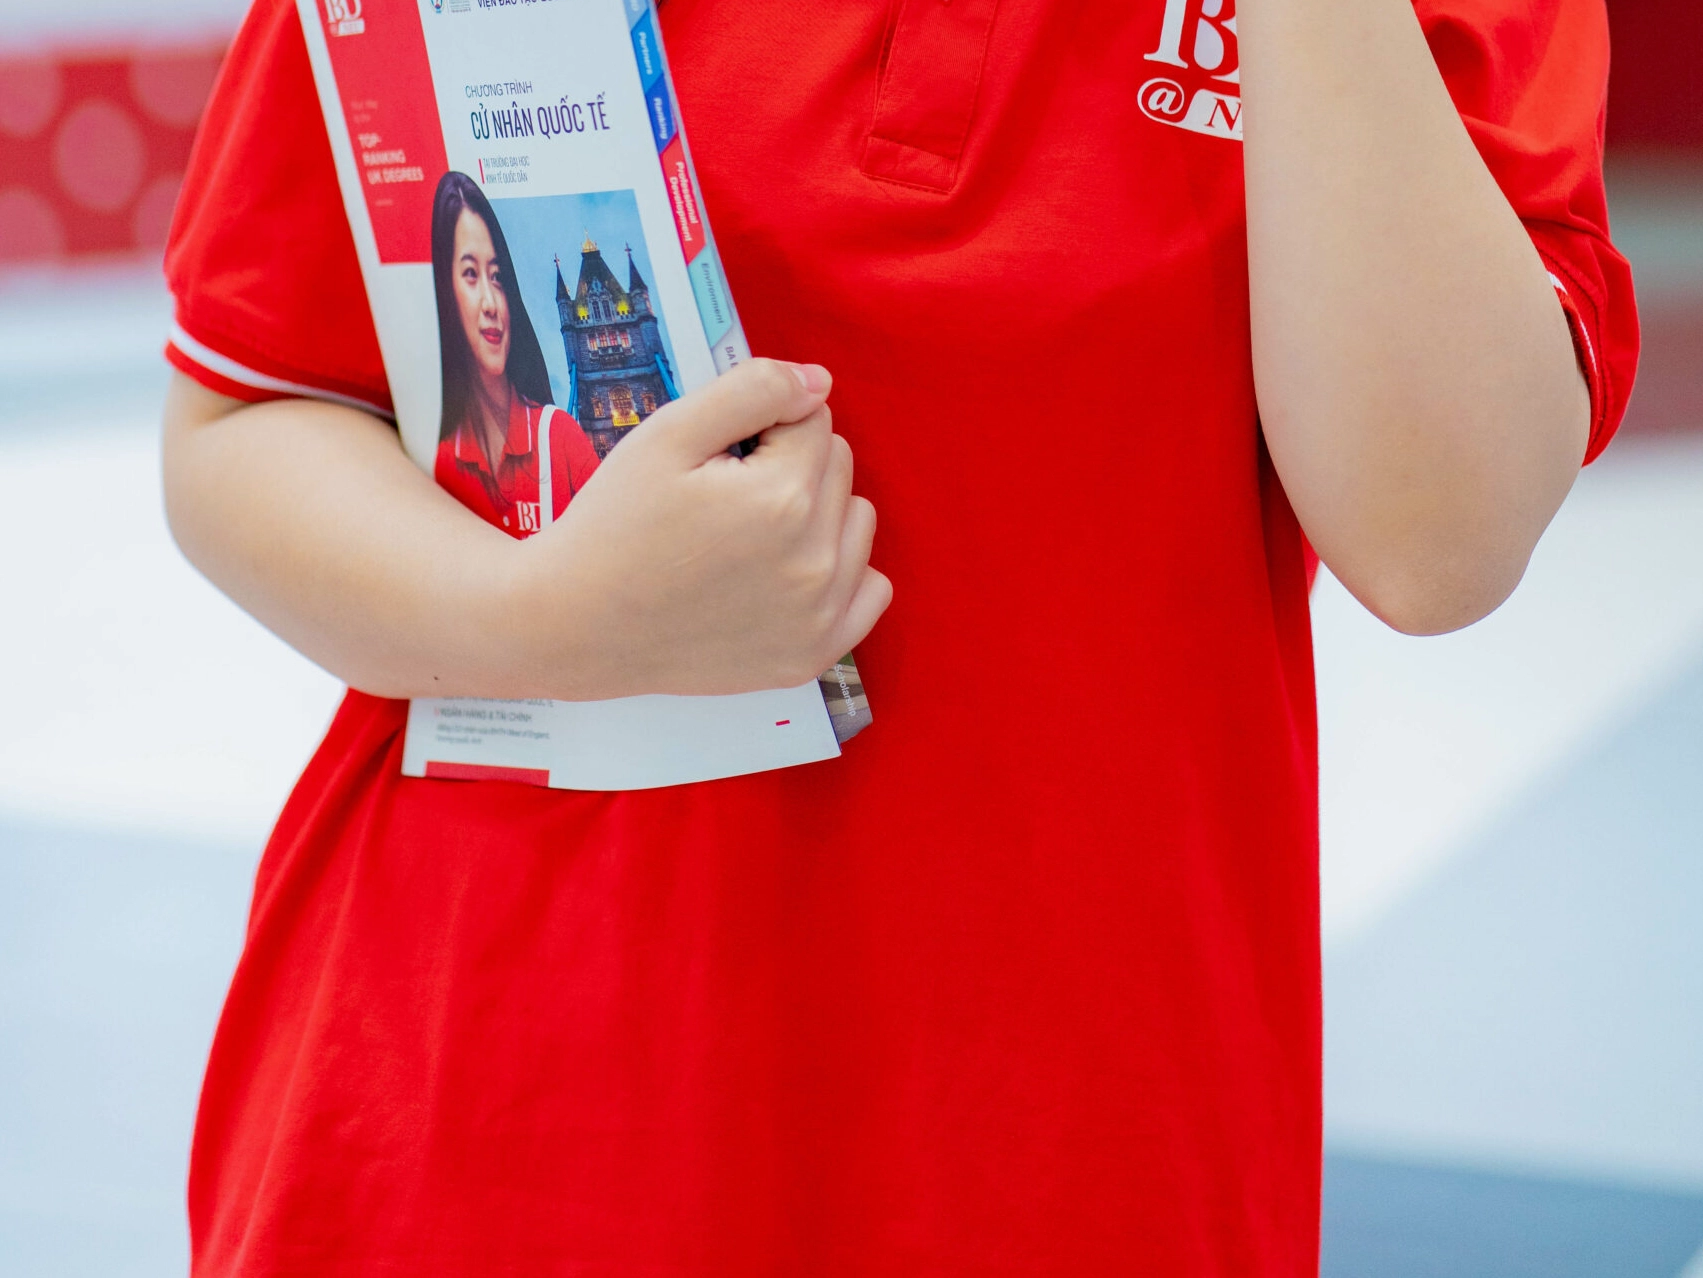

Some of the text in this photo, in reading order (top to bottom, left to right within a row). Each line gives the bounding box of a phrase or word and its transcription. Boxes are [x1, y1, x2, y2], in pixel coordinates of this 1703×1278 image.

[638, 31, 653, 75] Partners
[465, 79, 533, 98] CHƯƠNG TRÌNH
[470, 91, 610, 140] CỬ NHÂN QUỐC TẾ
[653, 97, 668, 140] Ranking
[362, 150, 406, 167] RANKING
[382, 166, 424, 184] DEGREES
[669, 176, 692, 242] Development
[675, 161, 699, 224] Professional
[701, 262, 724, 324] Environment
[725, 346, 736, 362] BA
[834, 664, 857, 717] Scholarship
